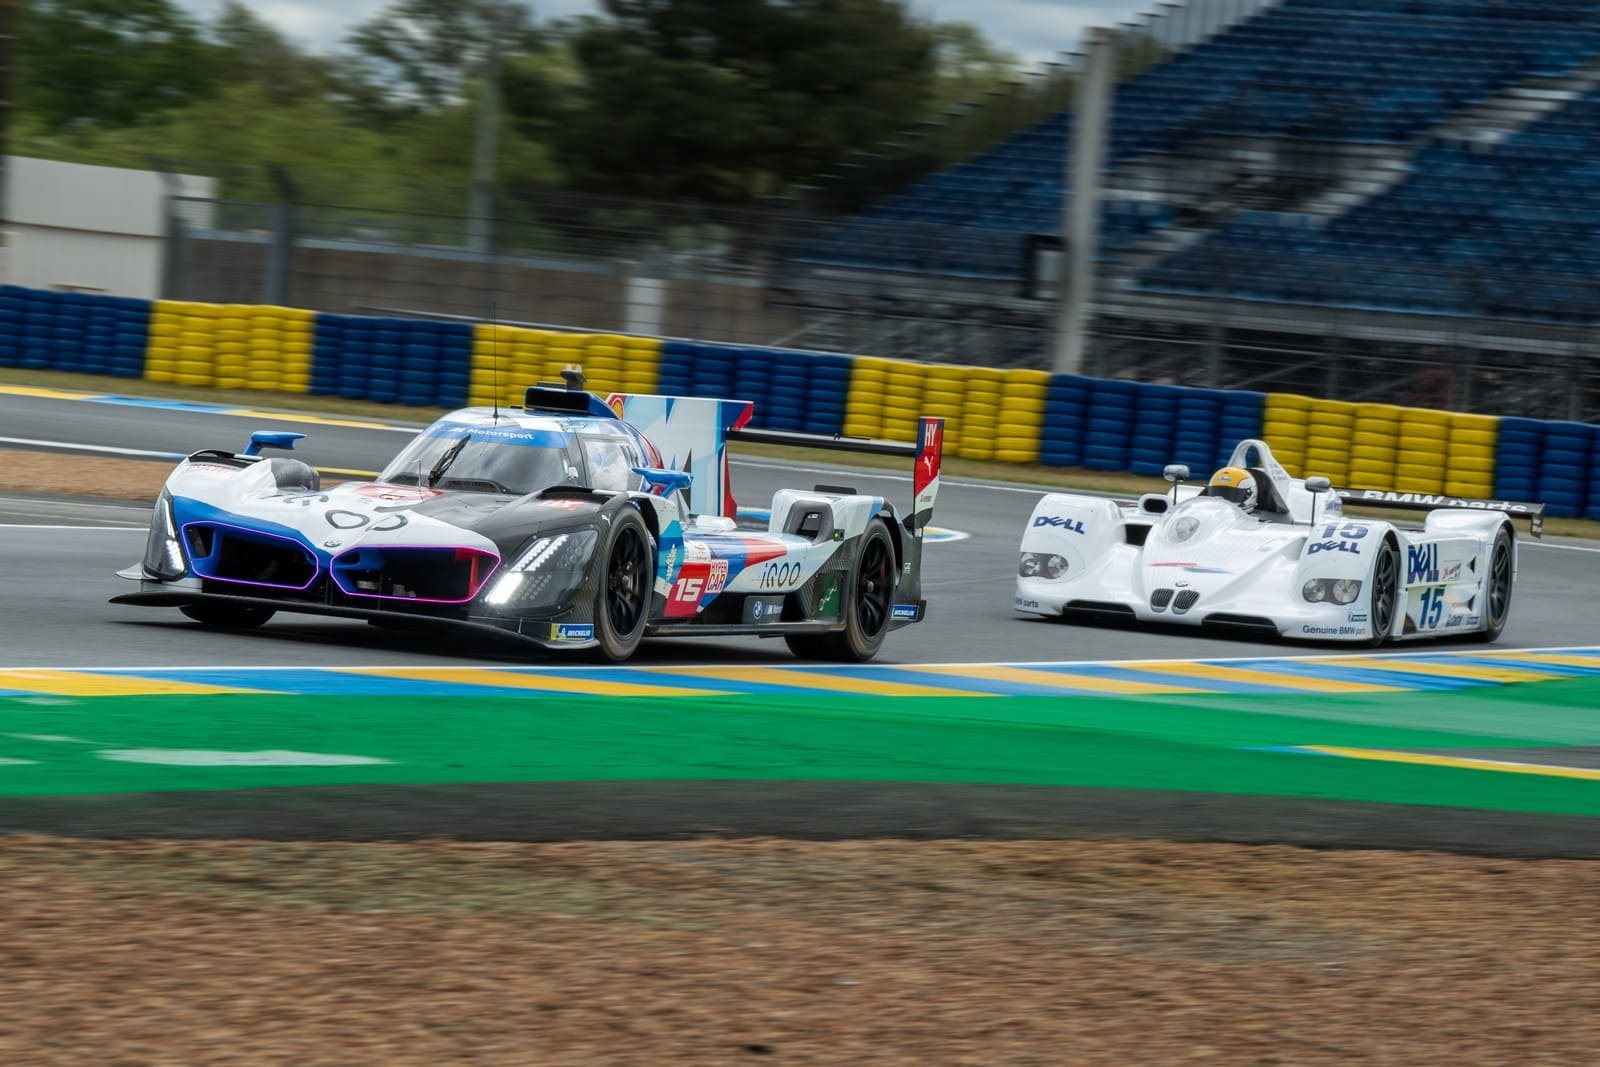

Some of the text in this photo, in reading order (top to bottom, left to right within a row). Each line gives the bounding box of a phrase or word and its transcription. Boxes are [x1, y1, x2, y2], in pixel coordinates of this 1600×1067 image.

[467, 428, 534, 440] Motorsport
[1363, 490, 1445, 505] BMW
[1448, 500, 1528, 512] parts
[1034, 516, 1085, 534] DELL
[1321, 522, 1369, 539] 15
[1308, 540, 1360, 555] DELL
[711, 561, 727, 573] HYPER
[1407, 543, 1439, 584] DELL
[674, 578, 704, 602] 15
[707, 573, 726, 591] CAR
[1419, 585, 1446, 629] 15
[1302, 624, 1338, 634] Genuine
[1339, 626, 1355, 634] BMW
